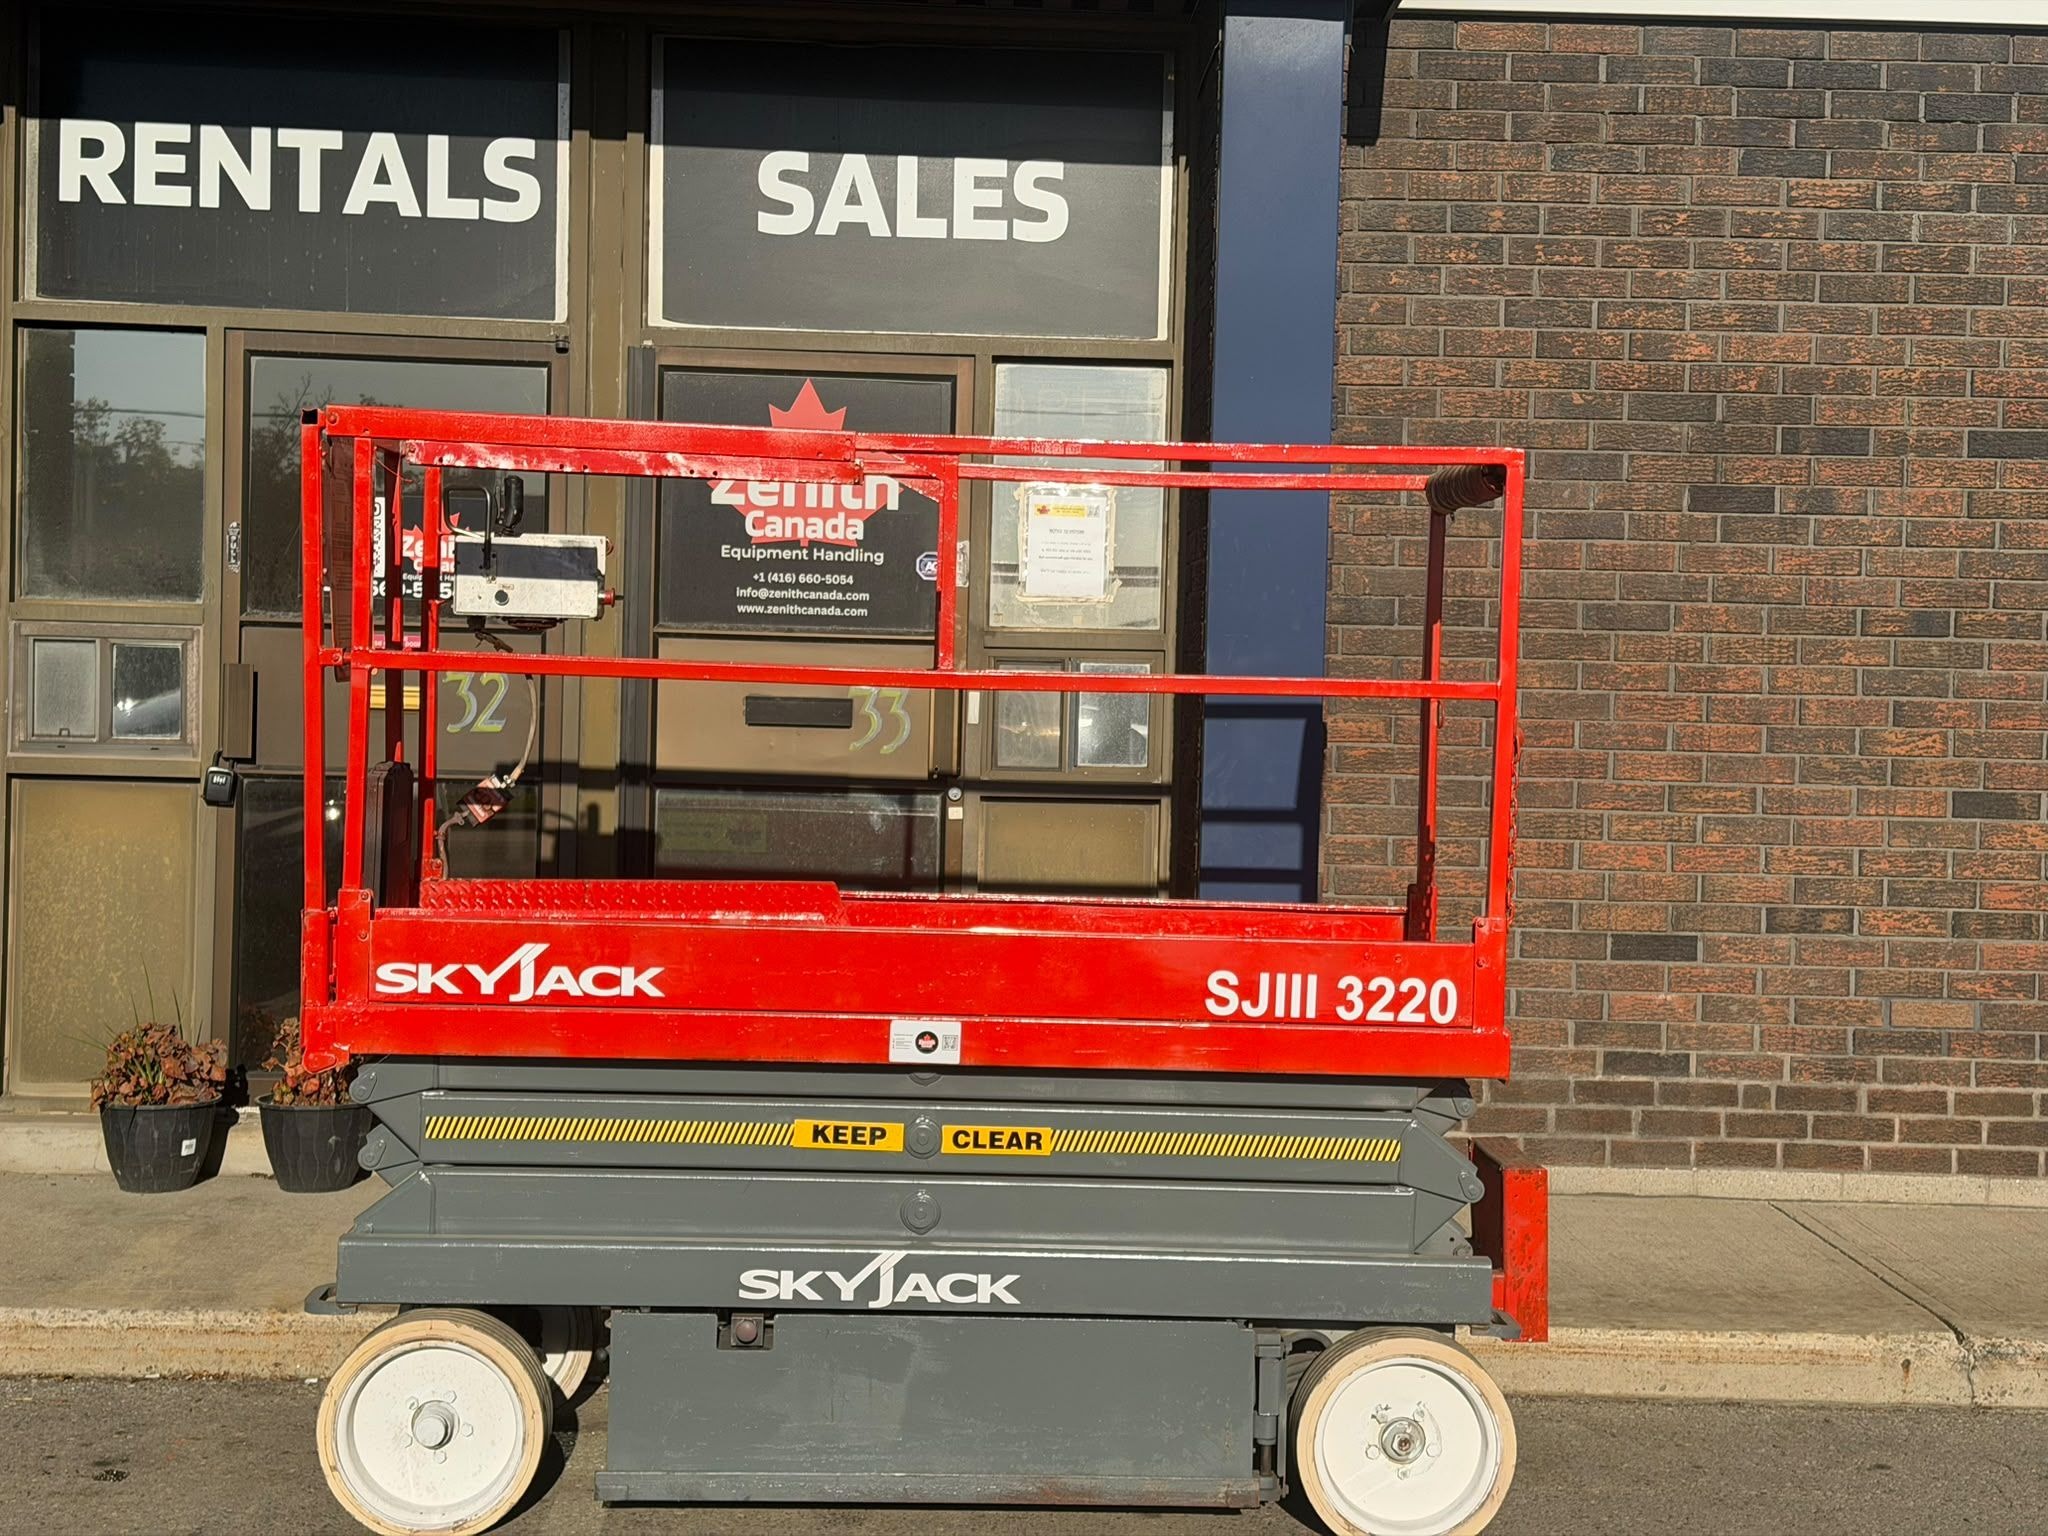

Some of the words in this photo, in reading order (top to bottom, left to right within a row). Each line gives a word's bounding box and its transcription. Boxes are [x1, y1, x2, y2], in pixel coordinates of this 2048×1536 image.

[58, 118, 541, 222] RENTALS
[757, 150, 1070, 243] SALES
[745, 510, 864, 541] Canada
[720, 544, 808, 562] Equipment
[813, 548, 885, 565] Handling
[753, 572, 766, 582] +1
[767, 572, 796, 584] (416)
[798, 573, 854, 585] 660-5054
[736, 586, 870, 602] info@zenithcanada.com
[736, 603, 868, 617] www.zenithcanada.com
[442, 671, 510, 734] 32
[848, 686, 911, 755] 33
[375, 943, 666, 1003] SKYJACK
[1204, 969, 1319, 1019] SJIII
[1335, 975, 1459, 1025] 3220
[811, 1124, 887, 1146] KEEP
[952, 1129, 1043, 1150] CLEAR
[738, 1250, 1022, 1309] SKYJACK
